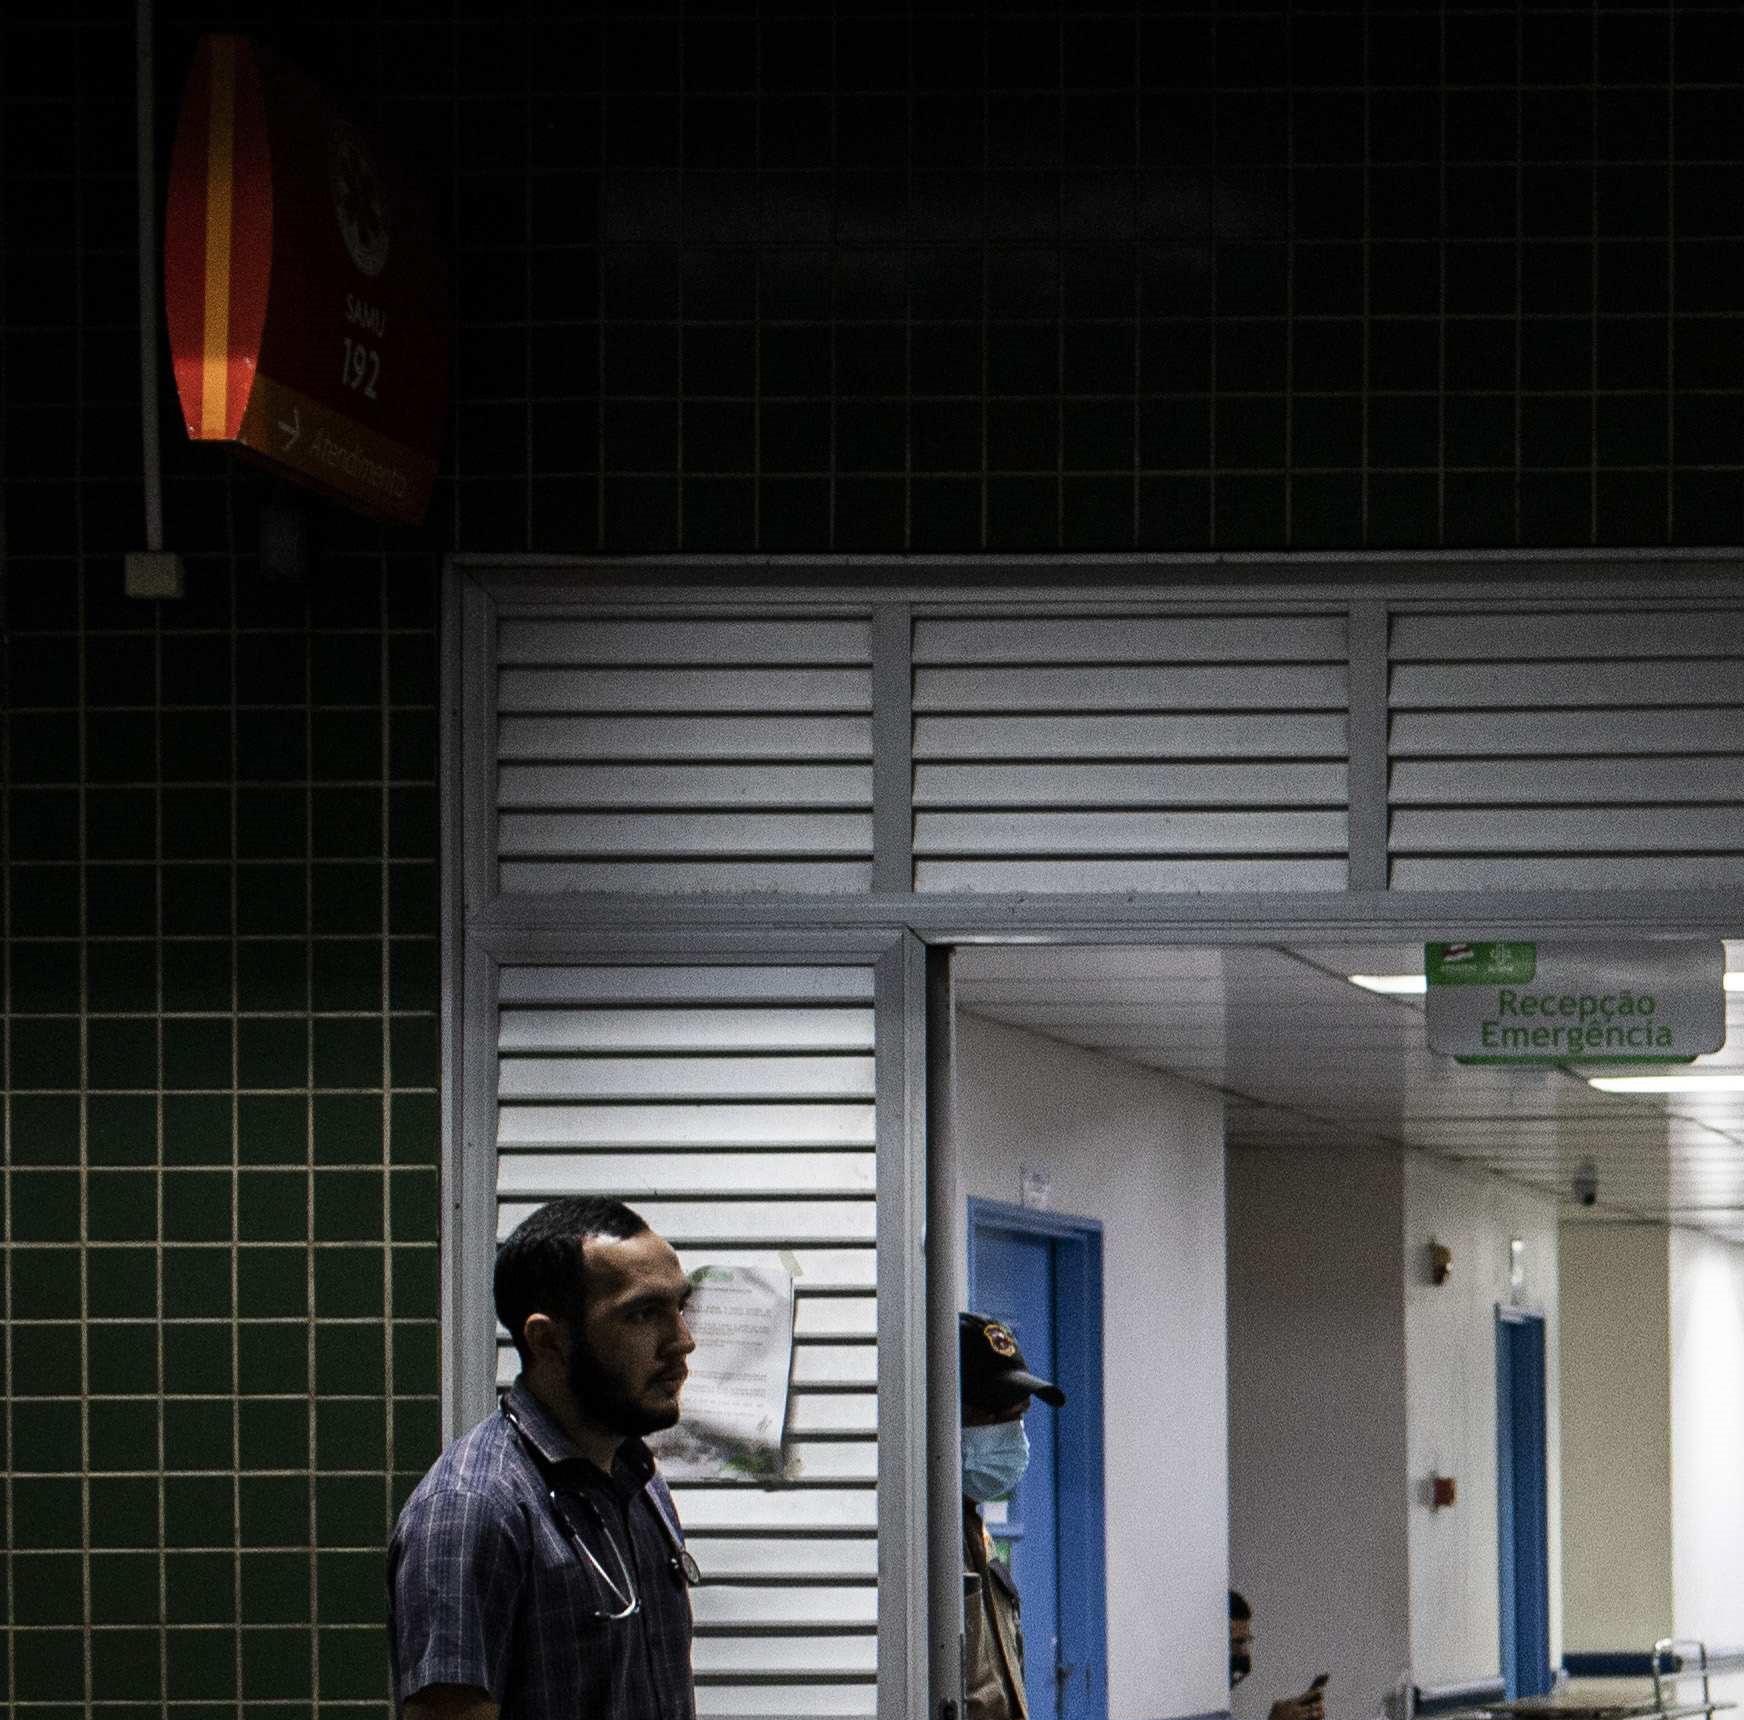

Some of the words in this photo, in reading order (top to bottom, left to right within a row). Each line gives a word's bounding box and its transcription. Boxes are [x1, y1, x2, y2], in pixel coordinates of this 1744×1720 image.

[345, 293, 388, 338] SAMU
[341, 337, 383, 401] 192
[1498, 990, 1657, 1022] Recepção
[1481, 1019, 1673, 1053] Emergência
